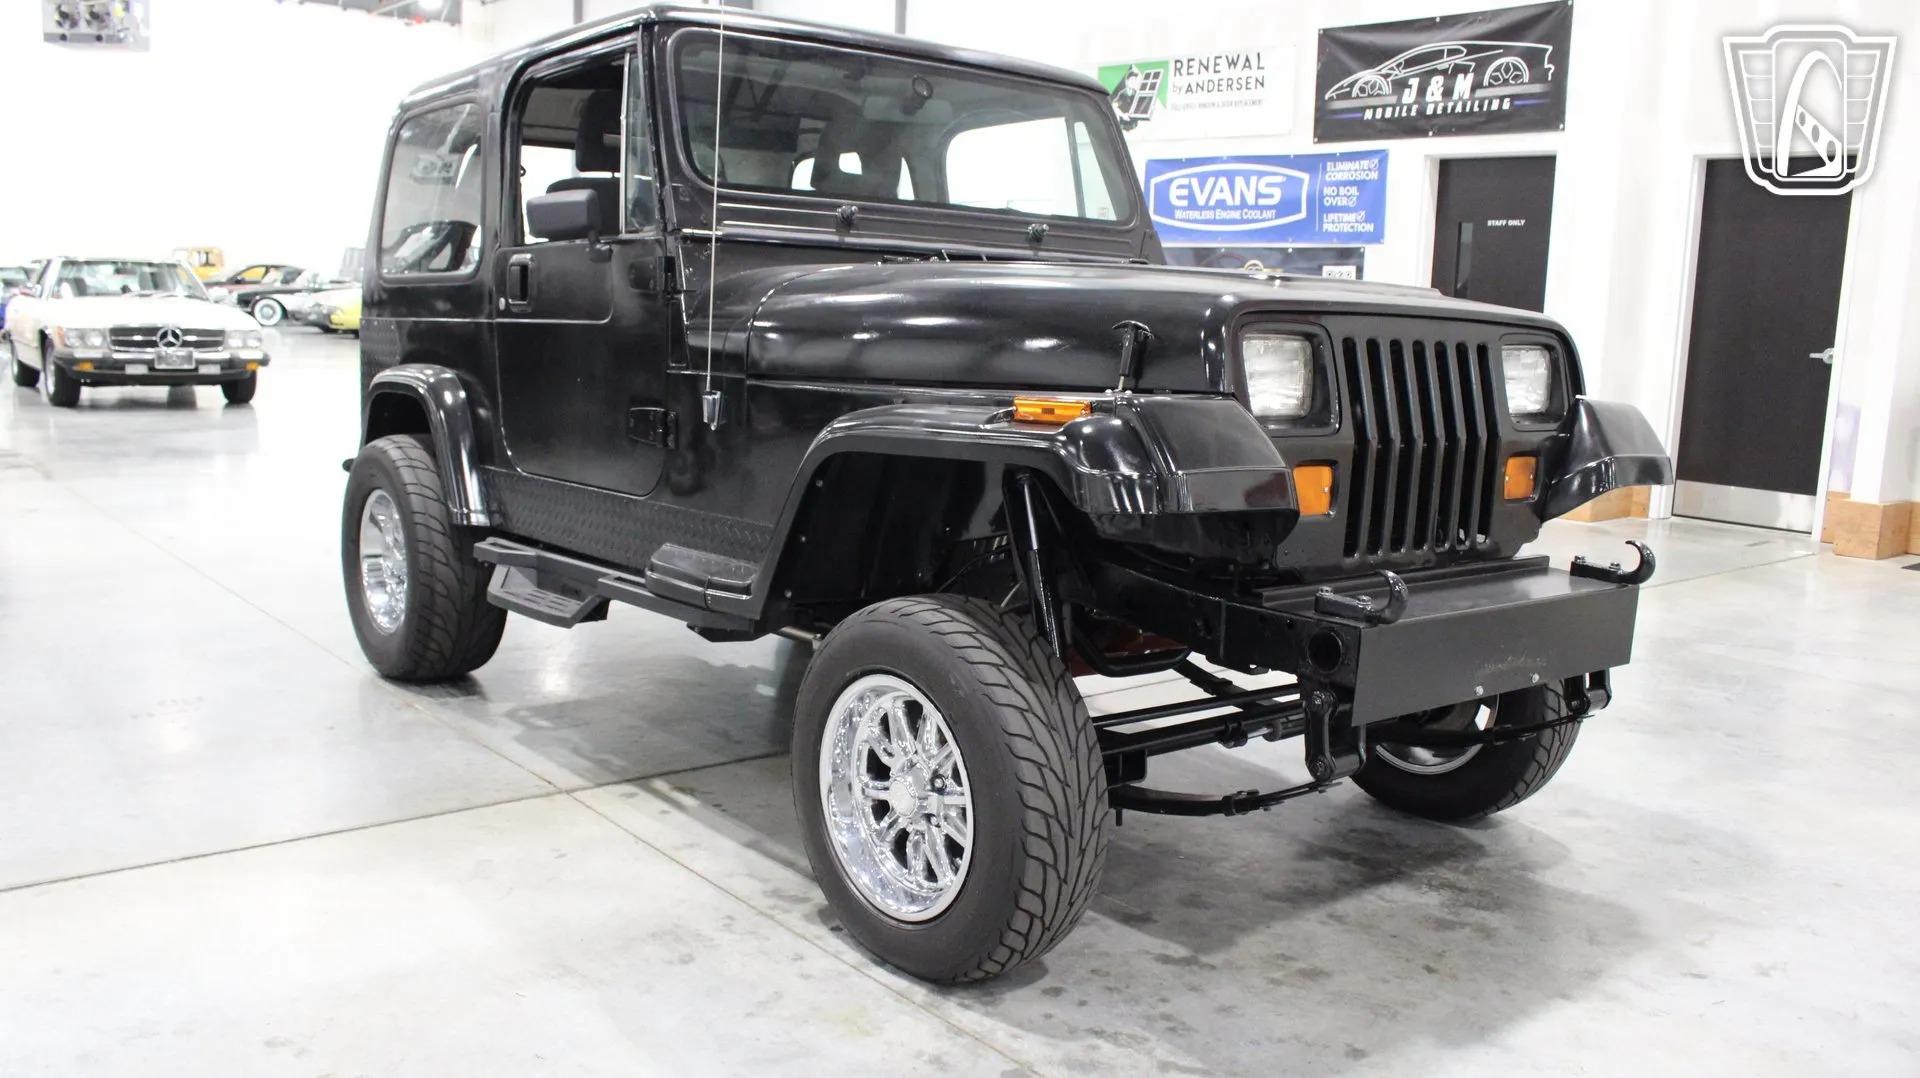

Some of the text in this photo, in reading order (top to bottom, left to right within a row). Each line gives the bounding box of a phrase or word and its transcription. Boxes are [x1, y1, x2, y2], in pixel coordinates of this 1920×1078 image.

[1173, 52, 1265, 78] RENEWAL
[1172, 75, 1265, 96] by ANDERSEN
[1401, 72, 1475, 104] J & M
[1363, 97, 1512, 120] MOBILE DETAILING
[1326, 160, 1370, 171] ELIMINATE
[1325, 170, 1379, 181] CORROSION
[1168, 175, 1283, 207] EVANS
[1323, 185, 1360, 196] NO BOIL
[1323, 196, 1348, 207] OVER
[1174, 208, 1277, 220] WATERLESS ENGINE COOLANT
[1323, 212, 1357, 223] LIFETIME
[1322, 222, 1375, 233] PROTECTION
[1487, 219, 1526, 227] STAFF ONLY
